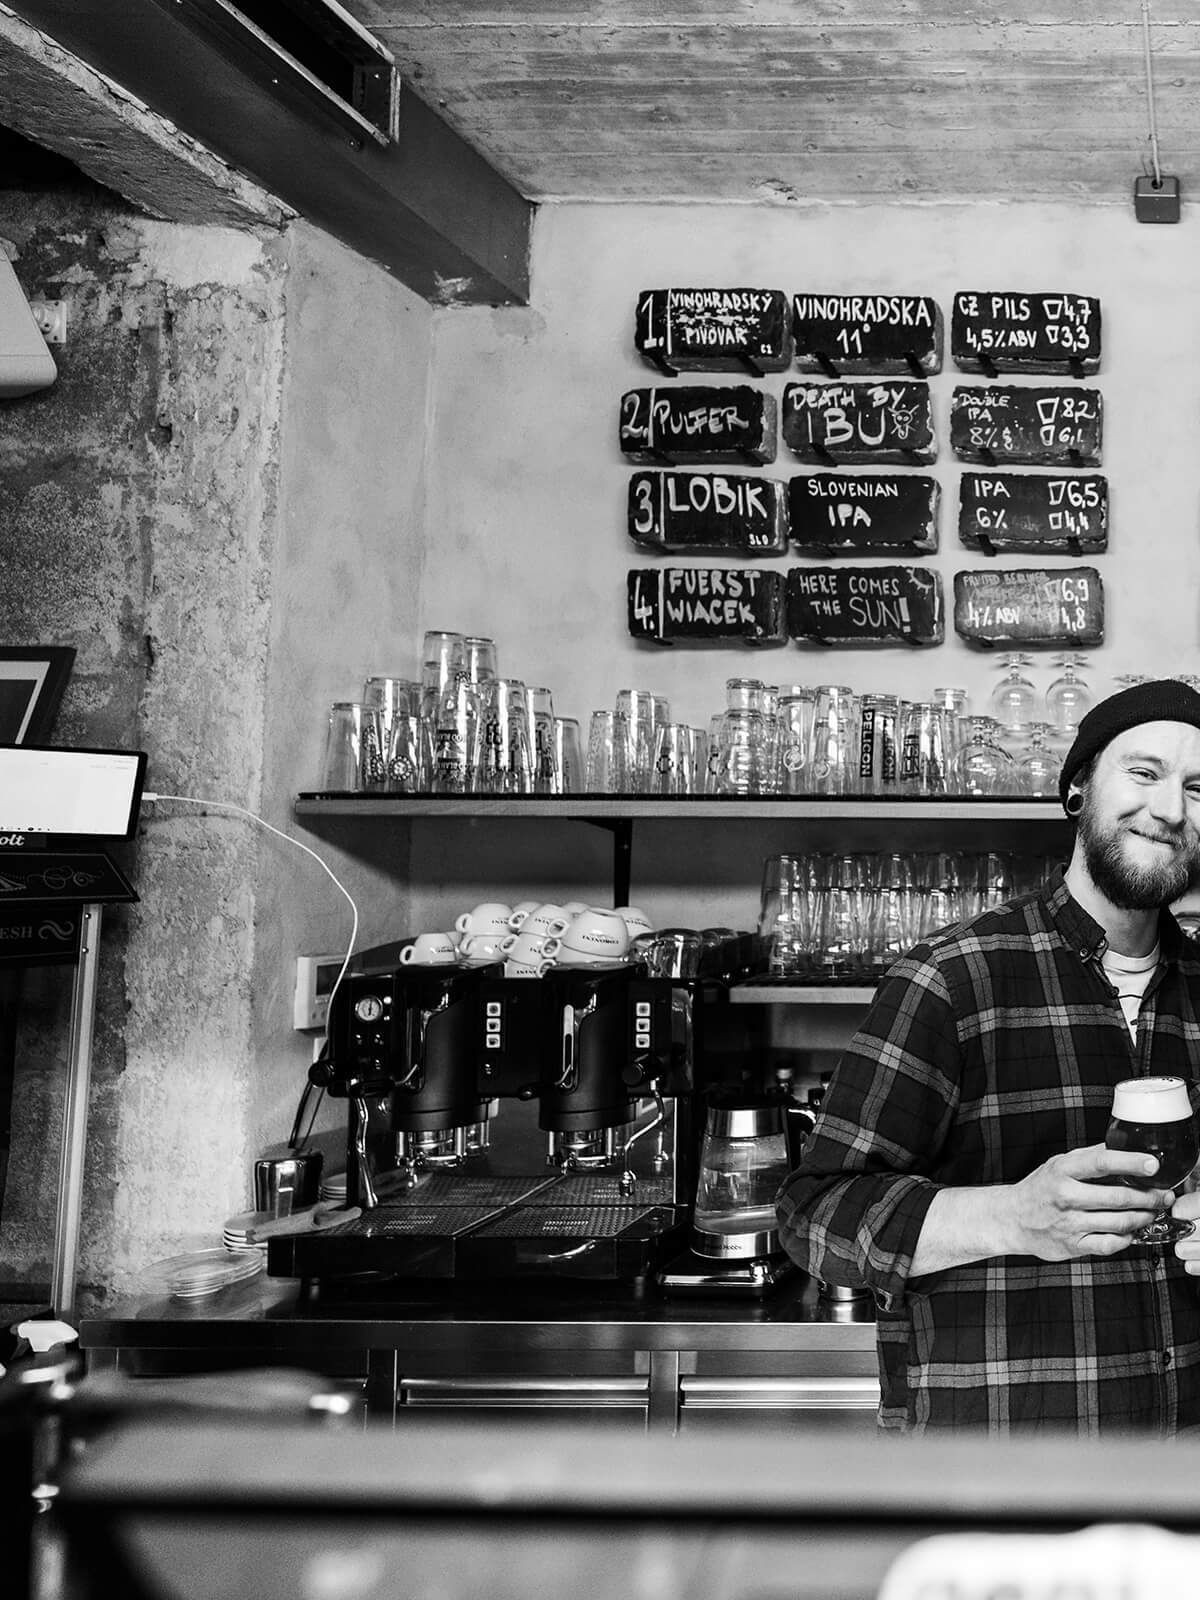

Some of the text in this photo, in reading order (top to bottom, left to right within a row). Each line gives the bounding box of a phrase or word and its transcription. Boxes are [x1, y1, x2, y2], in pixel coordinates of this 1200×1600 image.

[991, 297, 1030, 320] PILS
[685, 327, 748, 346] PIVOVAR
[1061, 325, 1089, 352] 3,3
[789, 386, 905, 410] DEATH BY
[968, 408, 992, 422] IPA
[667, 476, 768, 519] LOBIK
[808, 479, 899, 497] SLOVENIAN
[974, 479, 1011, 498] IPA
[1067, 481, 1099, 509] 6,5
[828, 503, 871, 527] IPA
[669, 570, 760, 598] FUERST
[800, 575, 900, 596] HERE COMES
[1062, 578, 1089, 606] 6,9
[667, 600, 756, 624] WIACEK
[810, 596, 911, 633] THE SUN!
[862, 711, 873, 775] PELICON
